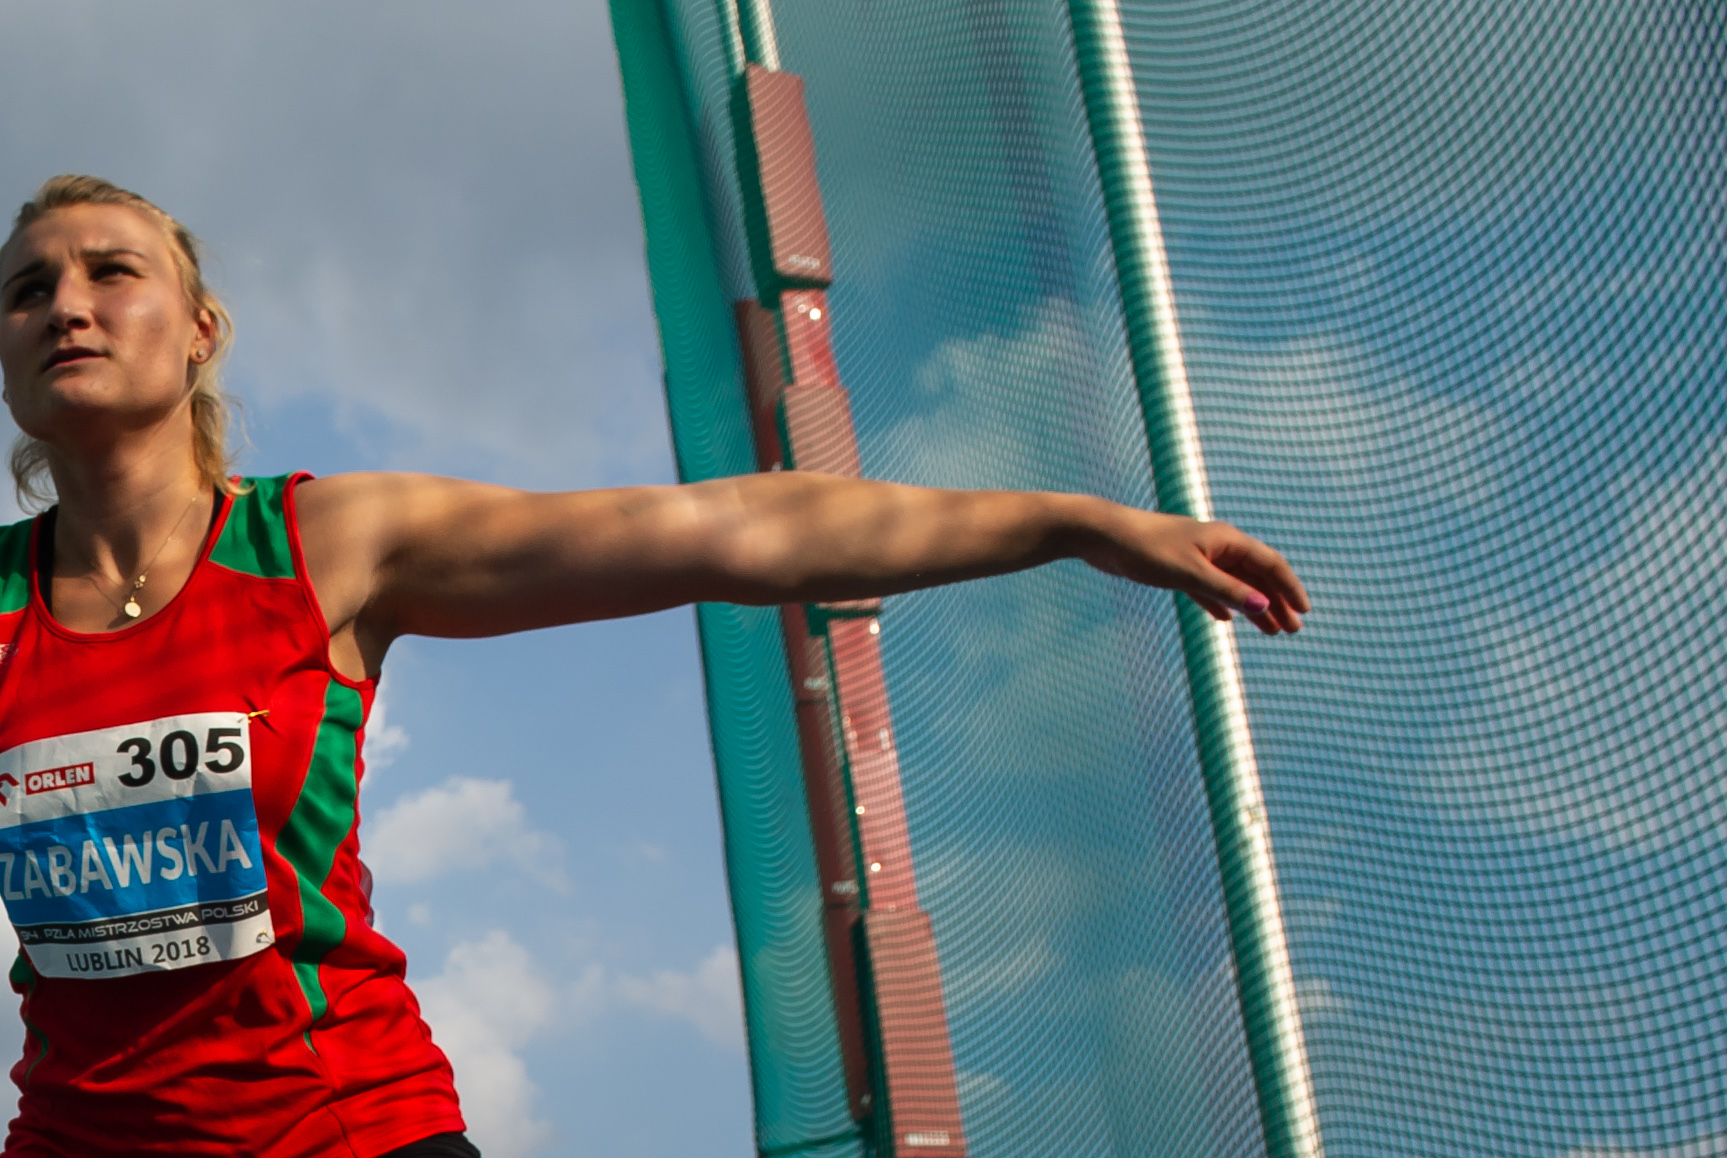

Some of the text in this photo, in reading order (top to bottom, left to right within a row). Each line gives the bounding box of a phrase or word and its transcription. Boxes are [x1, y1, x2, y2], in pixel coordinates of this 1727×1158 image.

[116, 727, 245, 788] 305
[28, 766, 90, 792] ORLEN
[44, 928, 75, 940] PZLA
[78, 911, 199, 939] MISTRZOSTWA
[201, 900, 259, 920] POLSKI
[66, 935, 211, 972] LUBLIN 2018
